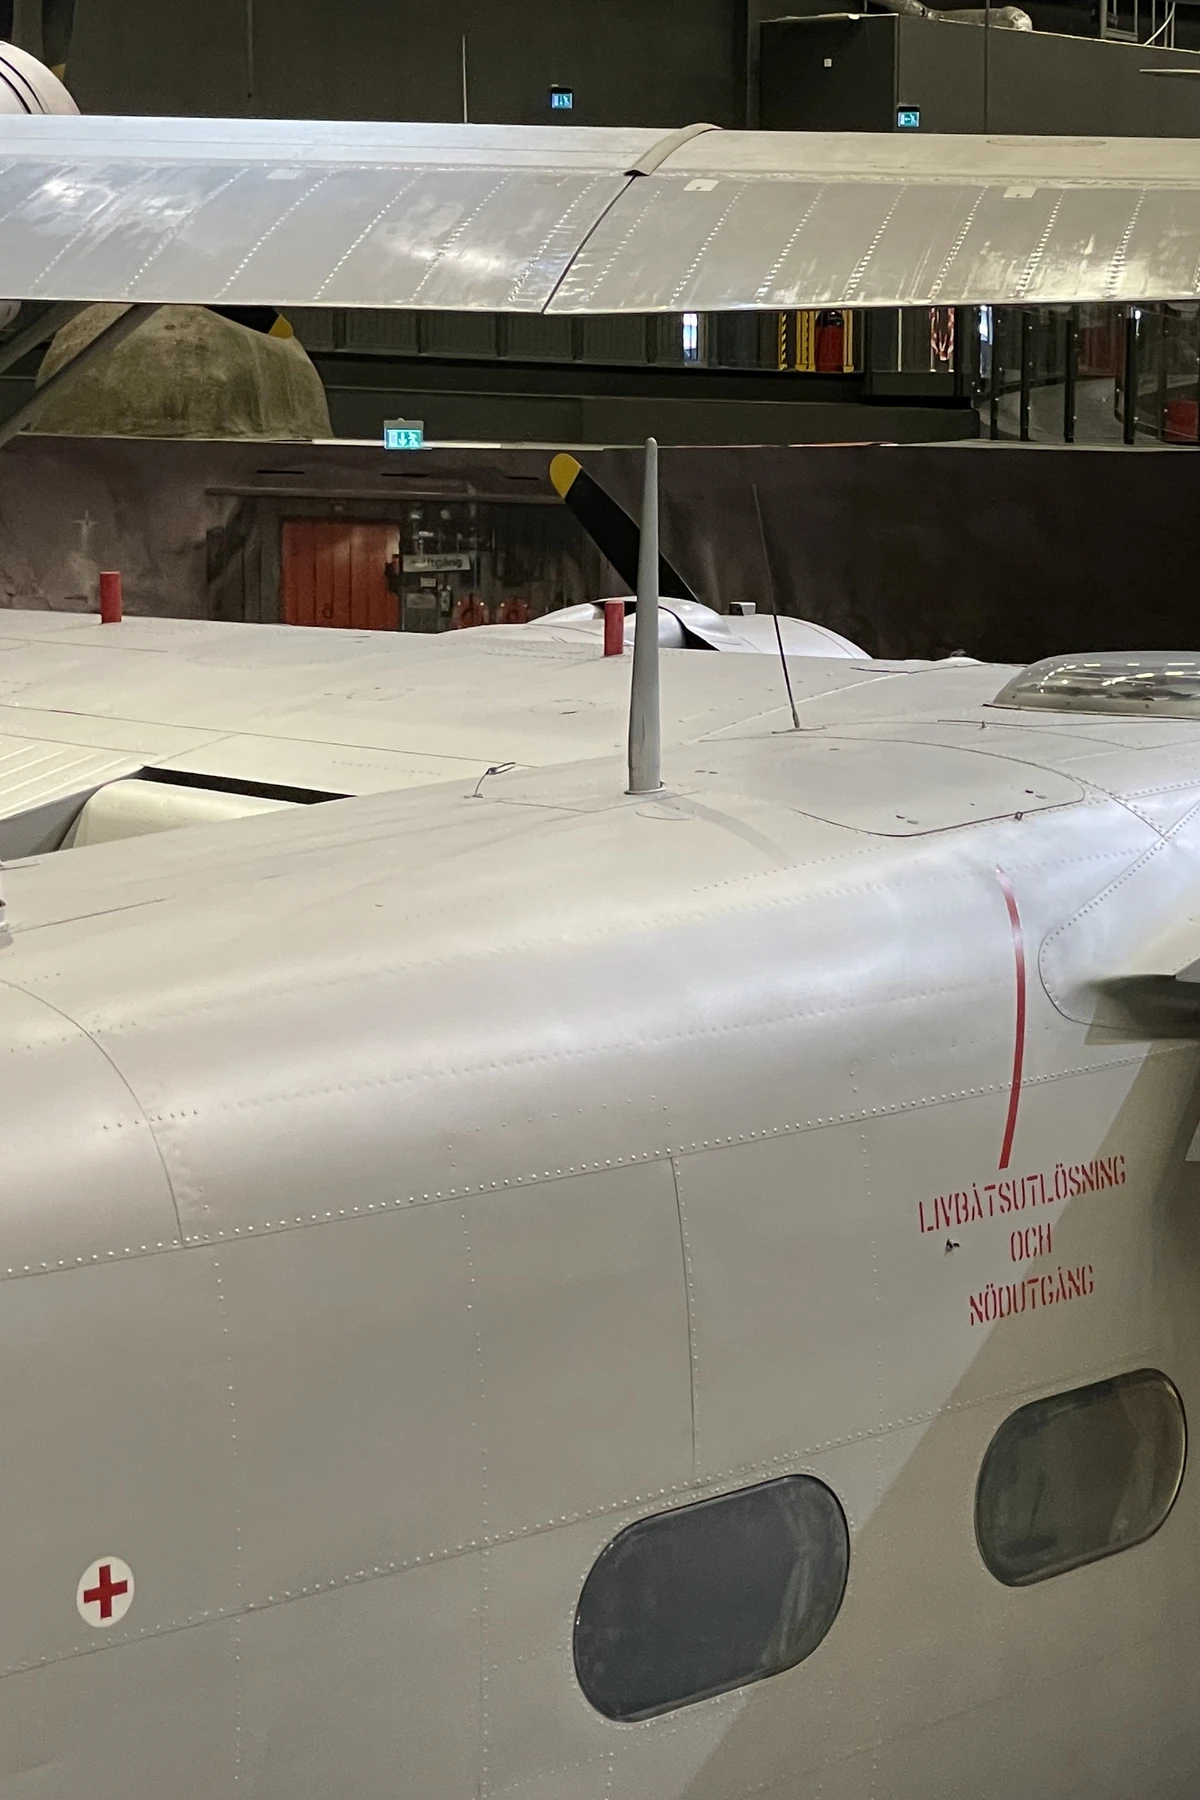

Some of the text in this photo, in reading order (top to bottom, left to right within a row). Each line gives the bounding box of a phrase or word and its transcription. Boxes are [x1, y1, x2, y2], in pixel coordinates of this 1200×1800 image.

[918, 1155, 1126, 1233] LIVBÅTSUTLÖSNING
[1010, 1223, 1052, 1262] OCH
[969, 1264, 1094, 1326] NÖDUTGÅNG
